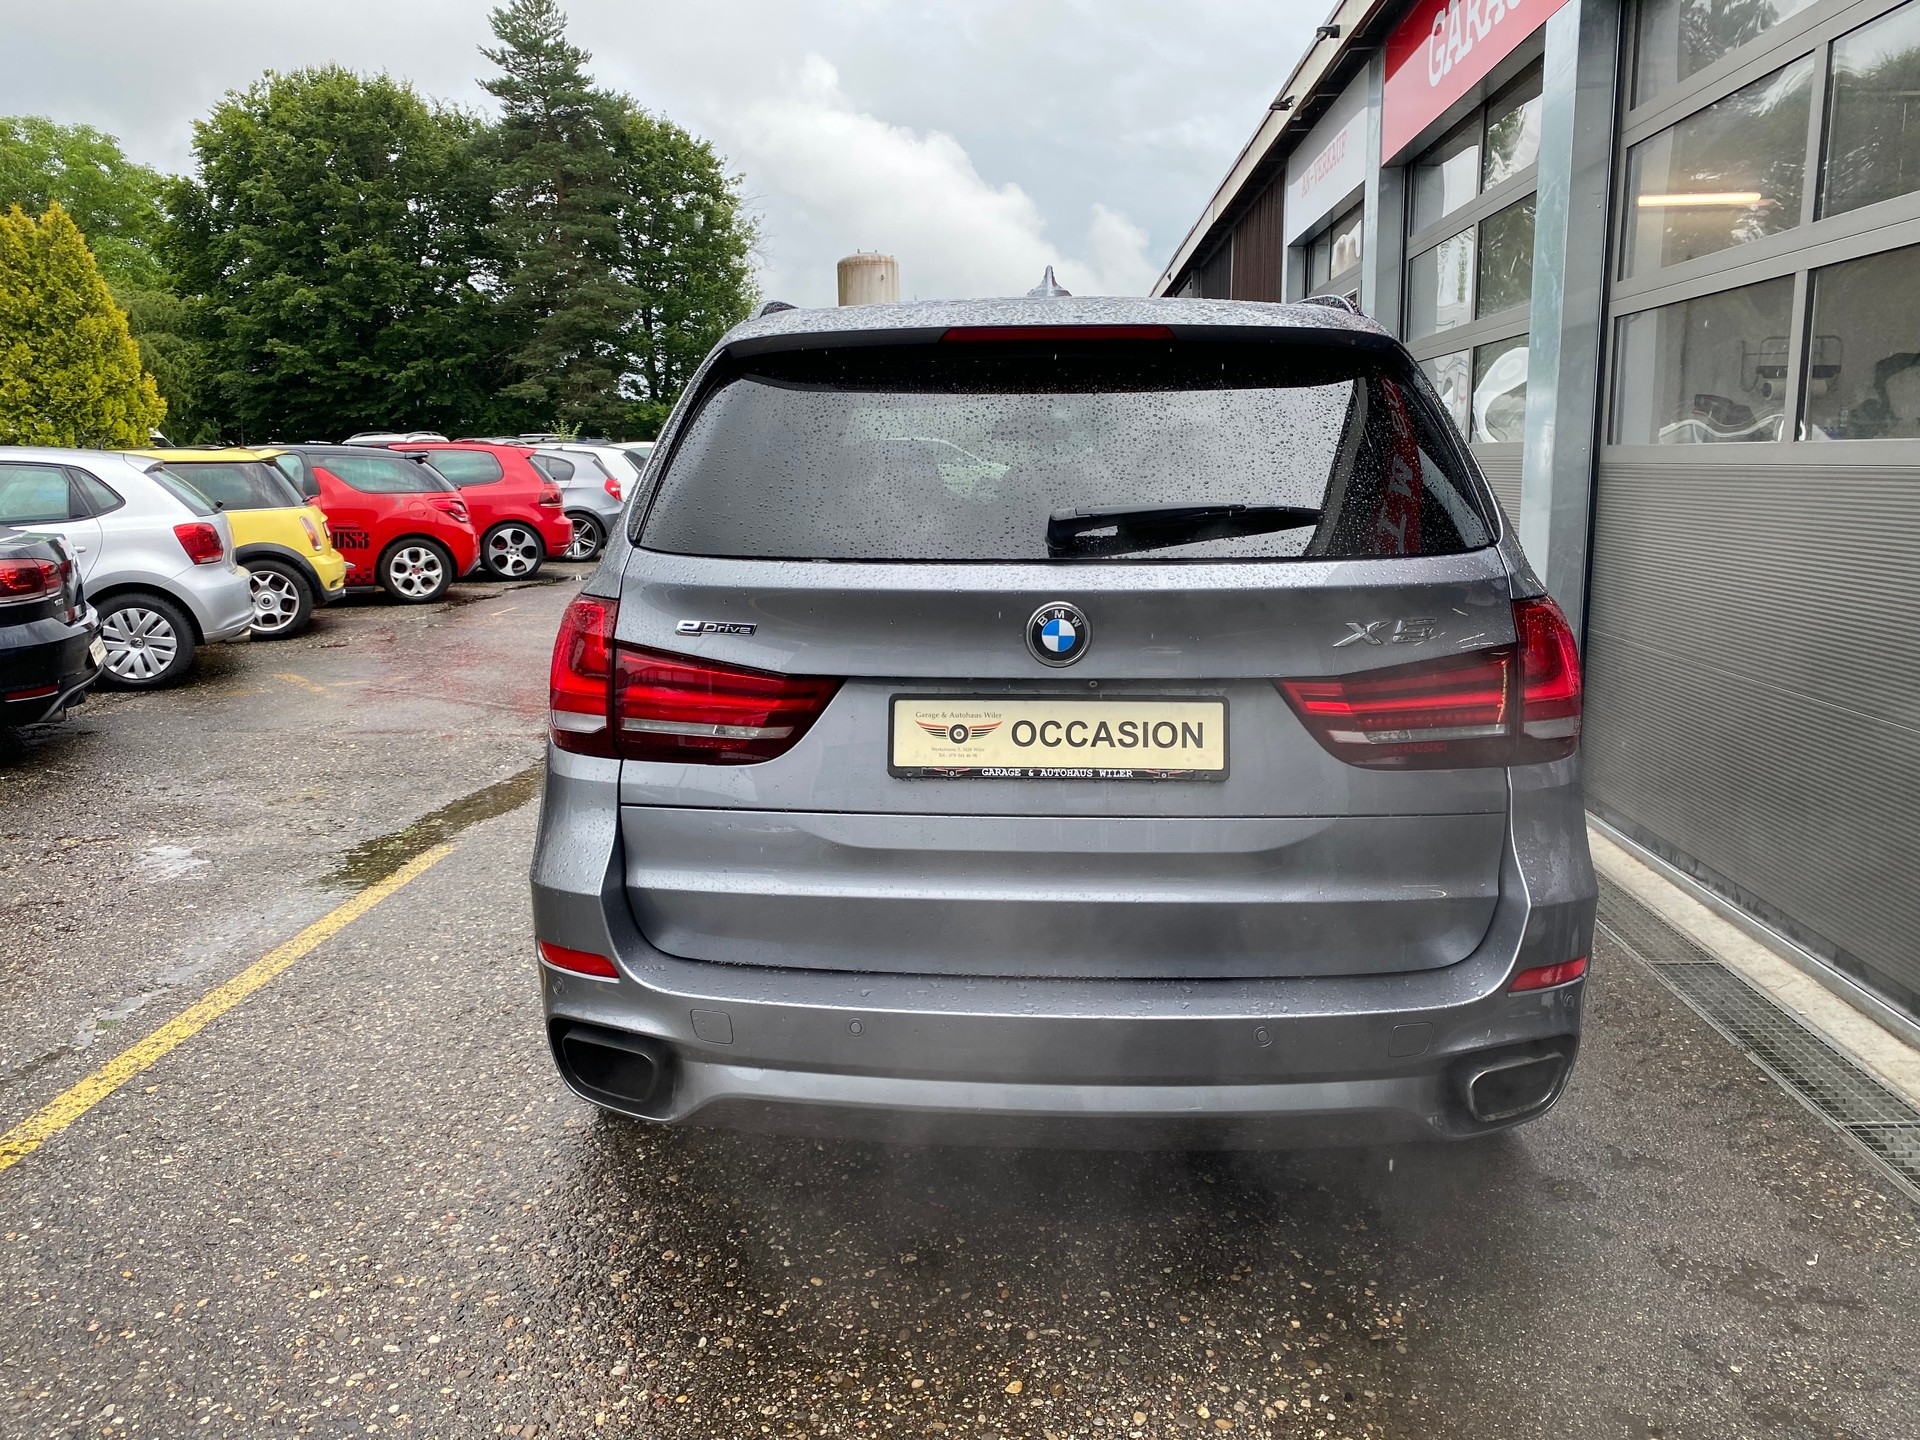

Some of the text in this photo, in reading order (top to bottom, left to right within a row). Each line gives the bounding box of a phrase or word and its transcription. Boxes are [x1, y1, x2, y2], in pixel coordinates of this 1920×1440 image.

[1037, 609, 1082, 627] BMW
[1332, 616, 1438, 648] X5
[915, 711, 1002, 720] Garage & Autohaus Wiler
[1011, 720, 1204, 749] OCCASION
[981, 768, 1133, 778] GARAGE & AUTOHAUS WILER
